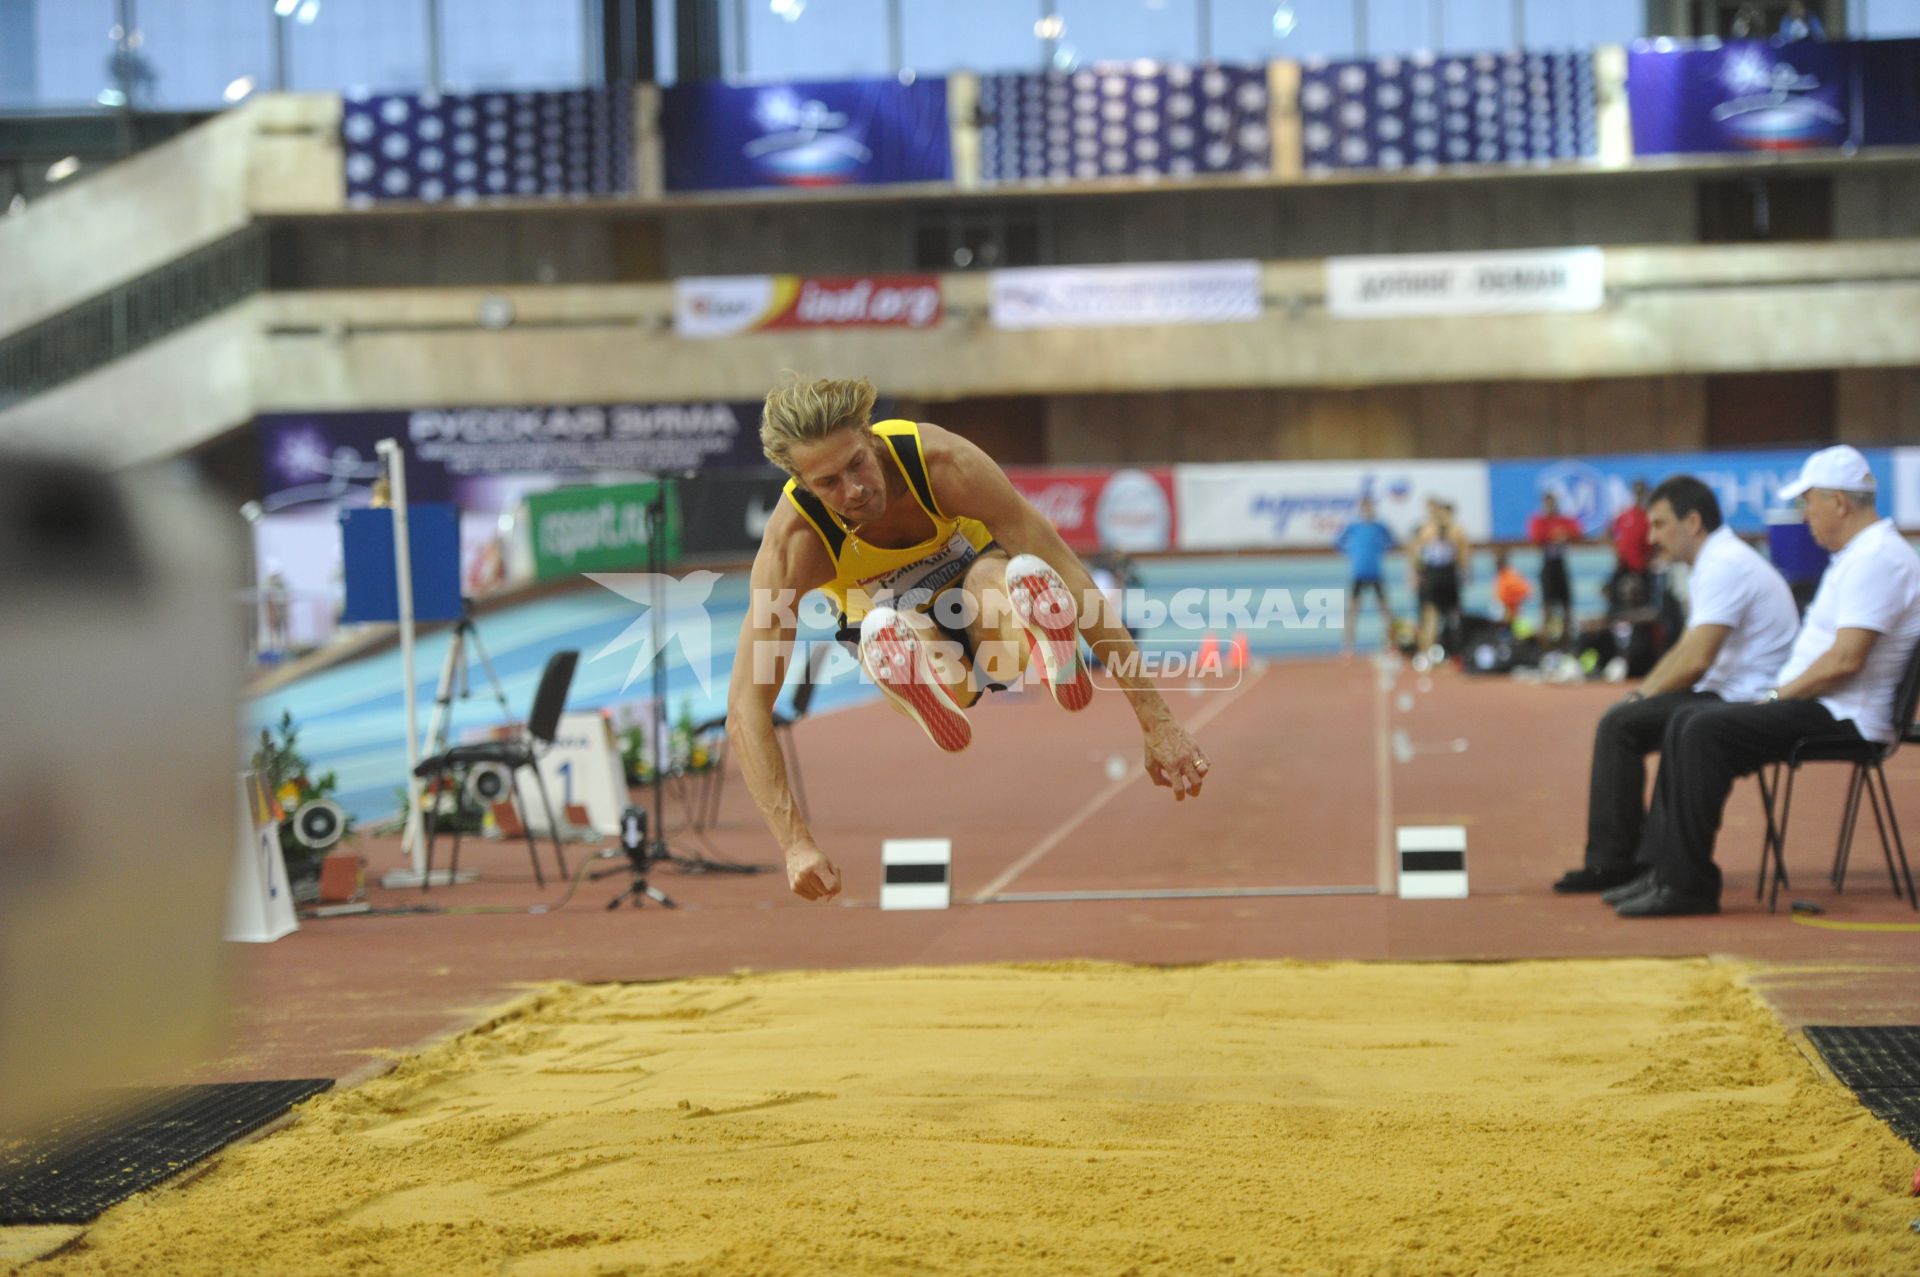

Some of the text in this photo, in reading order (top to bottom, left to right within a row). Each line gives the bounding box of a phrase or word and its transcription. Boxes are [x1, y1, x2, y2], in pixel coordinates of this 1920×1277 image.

[408, 404, 738, 443] РУССКАЯ ЗИМА
[922, 562, 961, 591] WINTER
